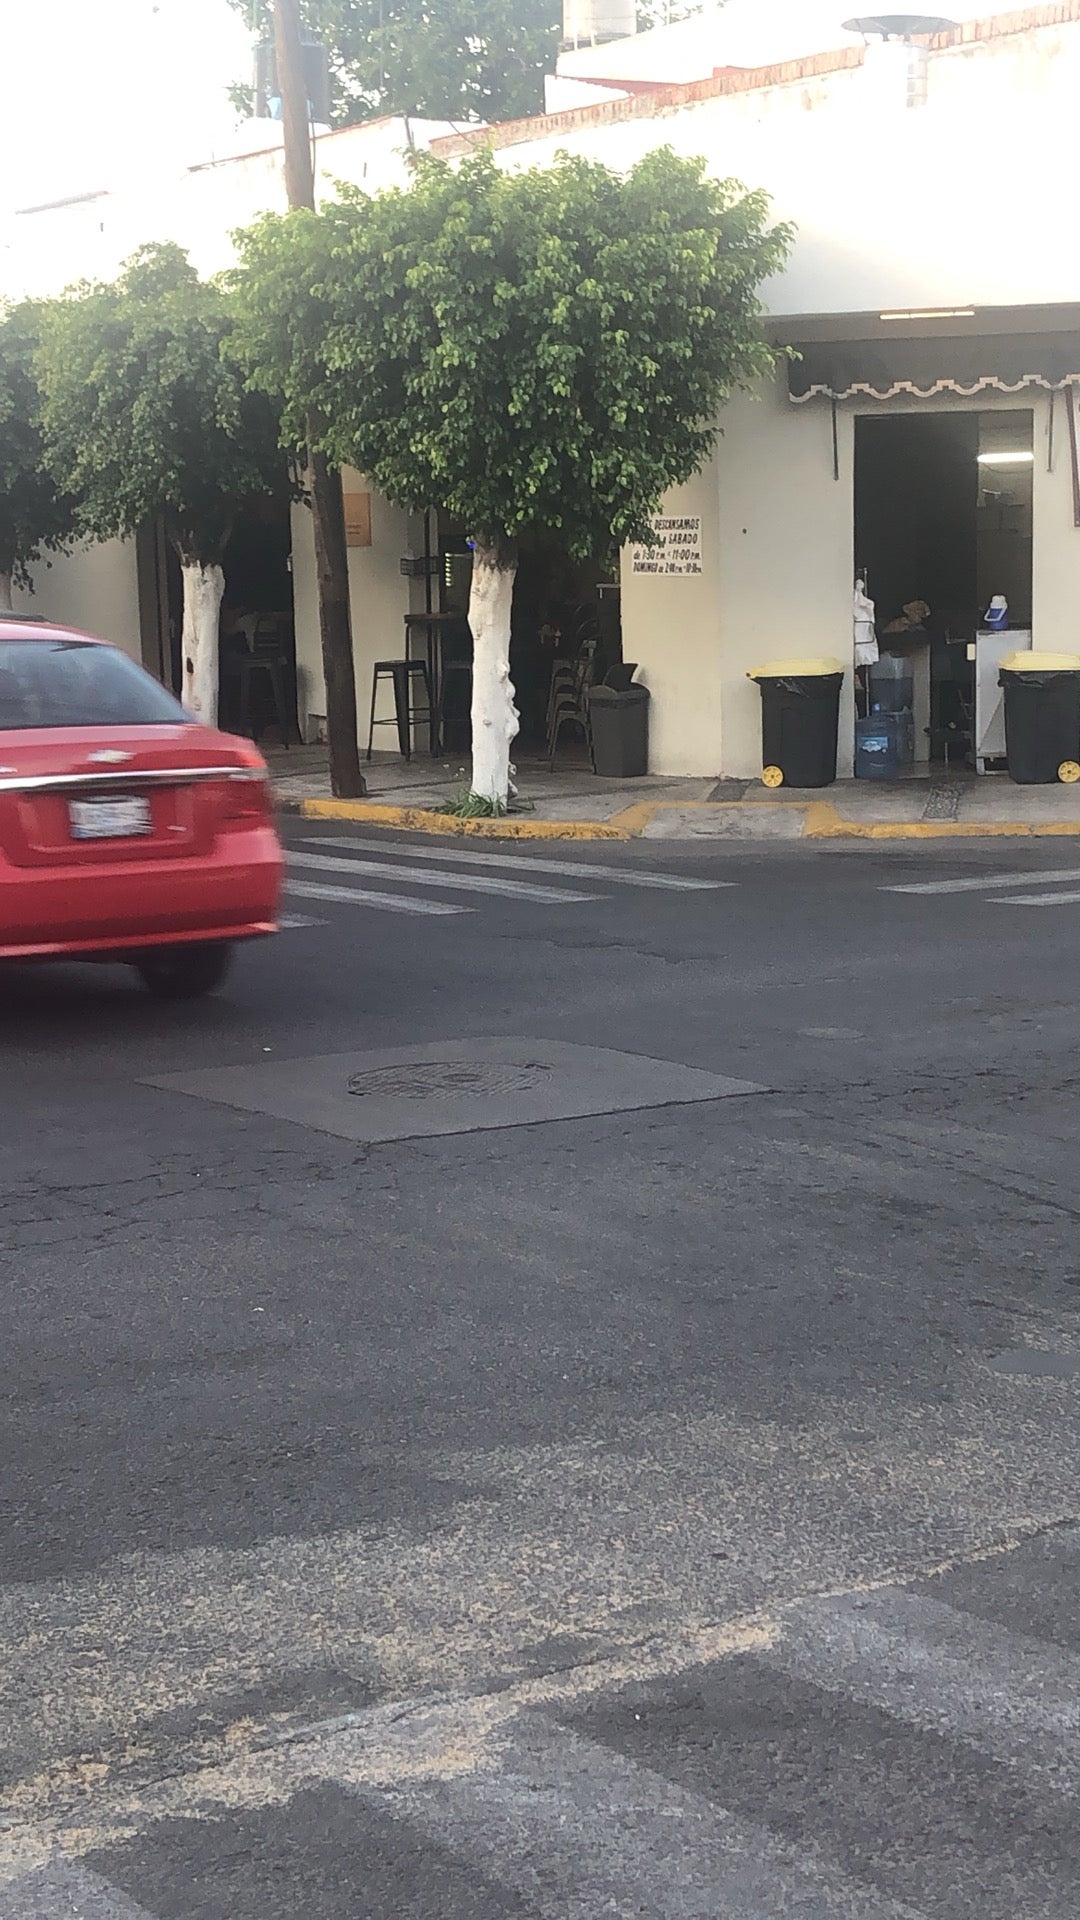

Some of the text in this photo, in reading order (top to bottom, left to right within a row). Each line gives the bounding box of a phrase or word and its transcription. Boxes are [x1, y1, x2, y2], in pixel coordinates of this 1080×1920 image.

[655, 518, 700, 530] DESCANSAMOS
[669, 533, 698, 544] SABADO
[633, 561, 658, 573] DOMINGO
